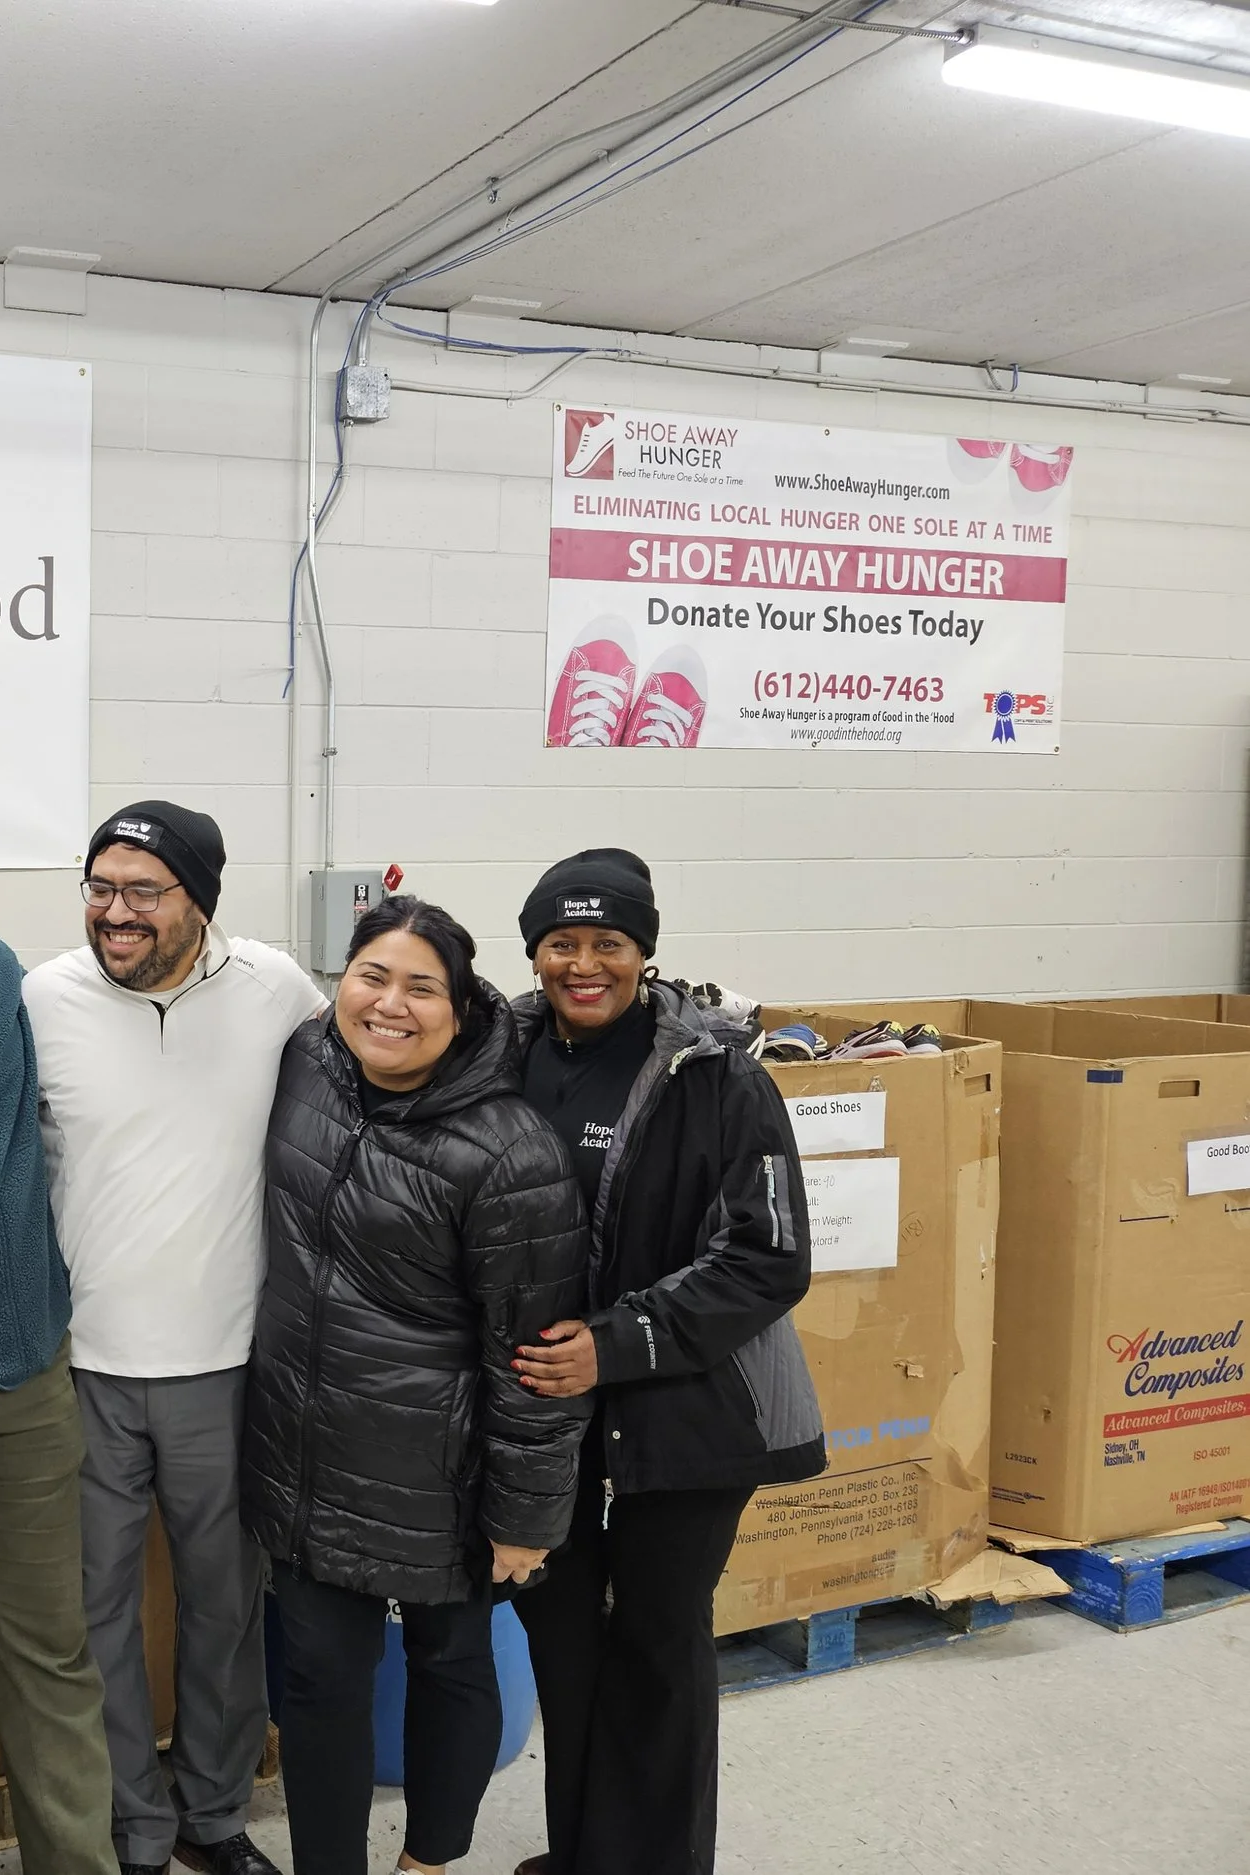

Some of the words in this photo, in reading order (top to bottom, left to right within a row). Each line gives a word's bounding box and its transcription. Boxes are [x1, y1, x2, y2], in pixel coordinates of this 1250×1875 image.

[624, 420, 677, 443] SHOE
[682, 425, 738, 447] AWAY
[640, 445, 722, 469] HUNGER
[618, 467, 636, 478] Feed
[638, 469, 650, 479] The
[652, 470, 675, 480] Future
[676, 472, 692, 482] One
[694, 473, 708, 483] Sole
[709, 476, 717, 484] at
[726, 476, 744, 486] Time
[774, 473, 950, 500] www.ShoeAwayHunger.com
[573, 494, 701, 522] ELIMINATING
[710, 504, 771, 525] LOCAL
[780, 508, 860, 531] HUNGER
[868, 514, 905, 534] ONE
[914, 517, 958, 537] SOLE
[966, 521, 987, 539] AT
[993, 522, 1005, 540] A
[1012, 524, 1052, 543] TIME
[627, 539, 733, 581] SHOE
[740, 546, 848, 587] AWAY
[856, 552, 1004, 595] HUNGER
[647, 598, 750, 629] Donate
[756, 602, 816, 633] Your
[823, 605, 902, 635] Shoes
[908, 609, 984, 646] Today
[754, 670, 944, 703] (612)440-7463
[739, 707, 760, 719] Shoe
[761, 708, 785, 722] Away
[787, 709, 817, 723] Hunger
[818, 709, 826, 721] is
[827, 712, 833, 721] a
[834, 712, 871, 724] program
[872, 710, 882, 722] of
[882, 711, 903, 722] Good
[904, 711, 913, 722] in
[915, 711, 929, 723] the
[790, 726, 902, 744] www.goodinthehood.org
[117, 821, 139, 831] Hope
[114, 828, 151, 843] Academy
[357, 884, 366, 897] ON
[563, 908, 605, 919] Academy
[564, 900, 588, 909] Hope
[796, 1102, 828, 1116] Good
[830, 1101, 862, 1114] Shoes
[583, 1122, 616, 1139] Hope
[578, 1135, 612, 1149] Acad
[1207, 1144, 1230, 1158] Good
[1232, 1144, 1250, 1155] Boo
[803, 1177, 821, 1187] are:
[807, 1196, 819, 1206] ull:
[809, 1217, 821, 1226] em
[822, 1215, 853, 1228] Weight:
[810, 1236, 833, 1248] ylord
[1106, 1319, 1244, 1363] Advanced
[1124, 1355, 1245, 1400] Composites
[1105, 1409, 1171, 1432] Advanced
[1174, 1400, 1247, 1420] Composites,
[824, 1426, 873, 1449] TON
[1105, 1442, 1128, 1455] Sidney,
[1129, 1439, 1139, 1451] OH
[1137, 1450, 1146, 1462] TN
[1193, 1450, 1208, 1461] ISO
[1210, 1446, 1230, 1458] 45001
[755, 1492, 816, 1511] Washington
[818, 1487, 844, 1500] Penn
[846, 1479, 878, 1494] Plastic
[902, 1471, 919, 1482] Inc.
[767, 1511, 786, 1523] 480
[789, 1503, 830, 1520] Johnson
[883, 1490, 900, 1501] Box
[902, 1484, 919, 1496] 236
[1175, 1498, 1212, 1515] Registered
[1213, 1494, 1244, 1508] Company
[735, 1527, 798, 1545] Washington,
[800, 1509, 864, 1533] Pennsylvania
[867, 1501, 919, 1519] 15301-6183
[817, 1530, 847, 1545] Phone
[849, 1525, 874, 1541] (724)
[876, 1515, 918, 1532] 228-1260
